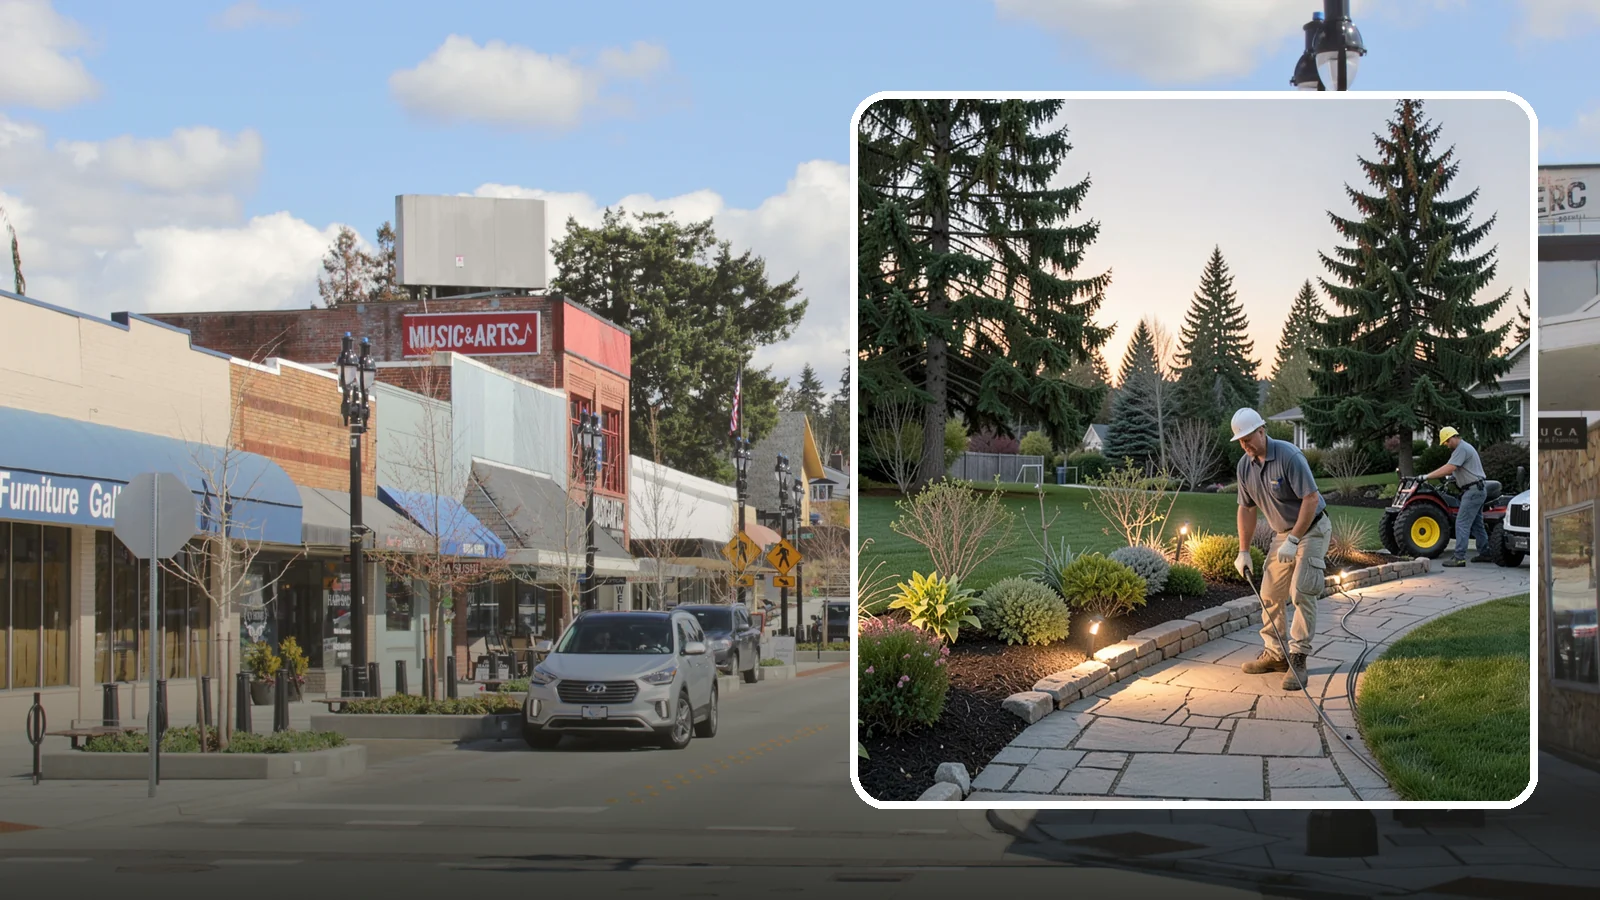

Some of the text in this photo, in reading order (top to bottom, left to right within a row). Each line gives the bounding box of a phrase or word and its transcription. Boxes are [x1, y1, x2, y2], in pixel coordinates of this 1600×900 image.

[1540, 427, 1578, 437] UGA
[0, 472, 79, 515] Furniture
[453, 563, 479, 574] SUSHI
